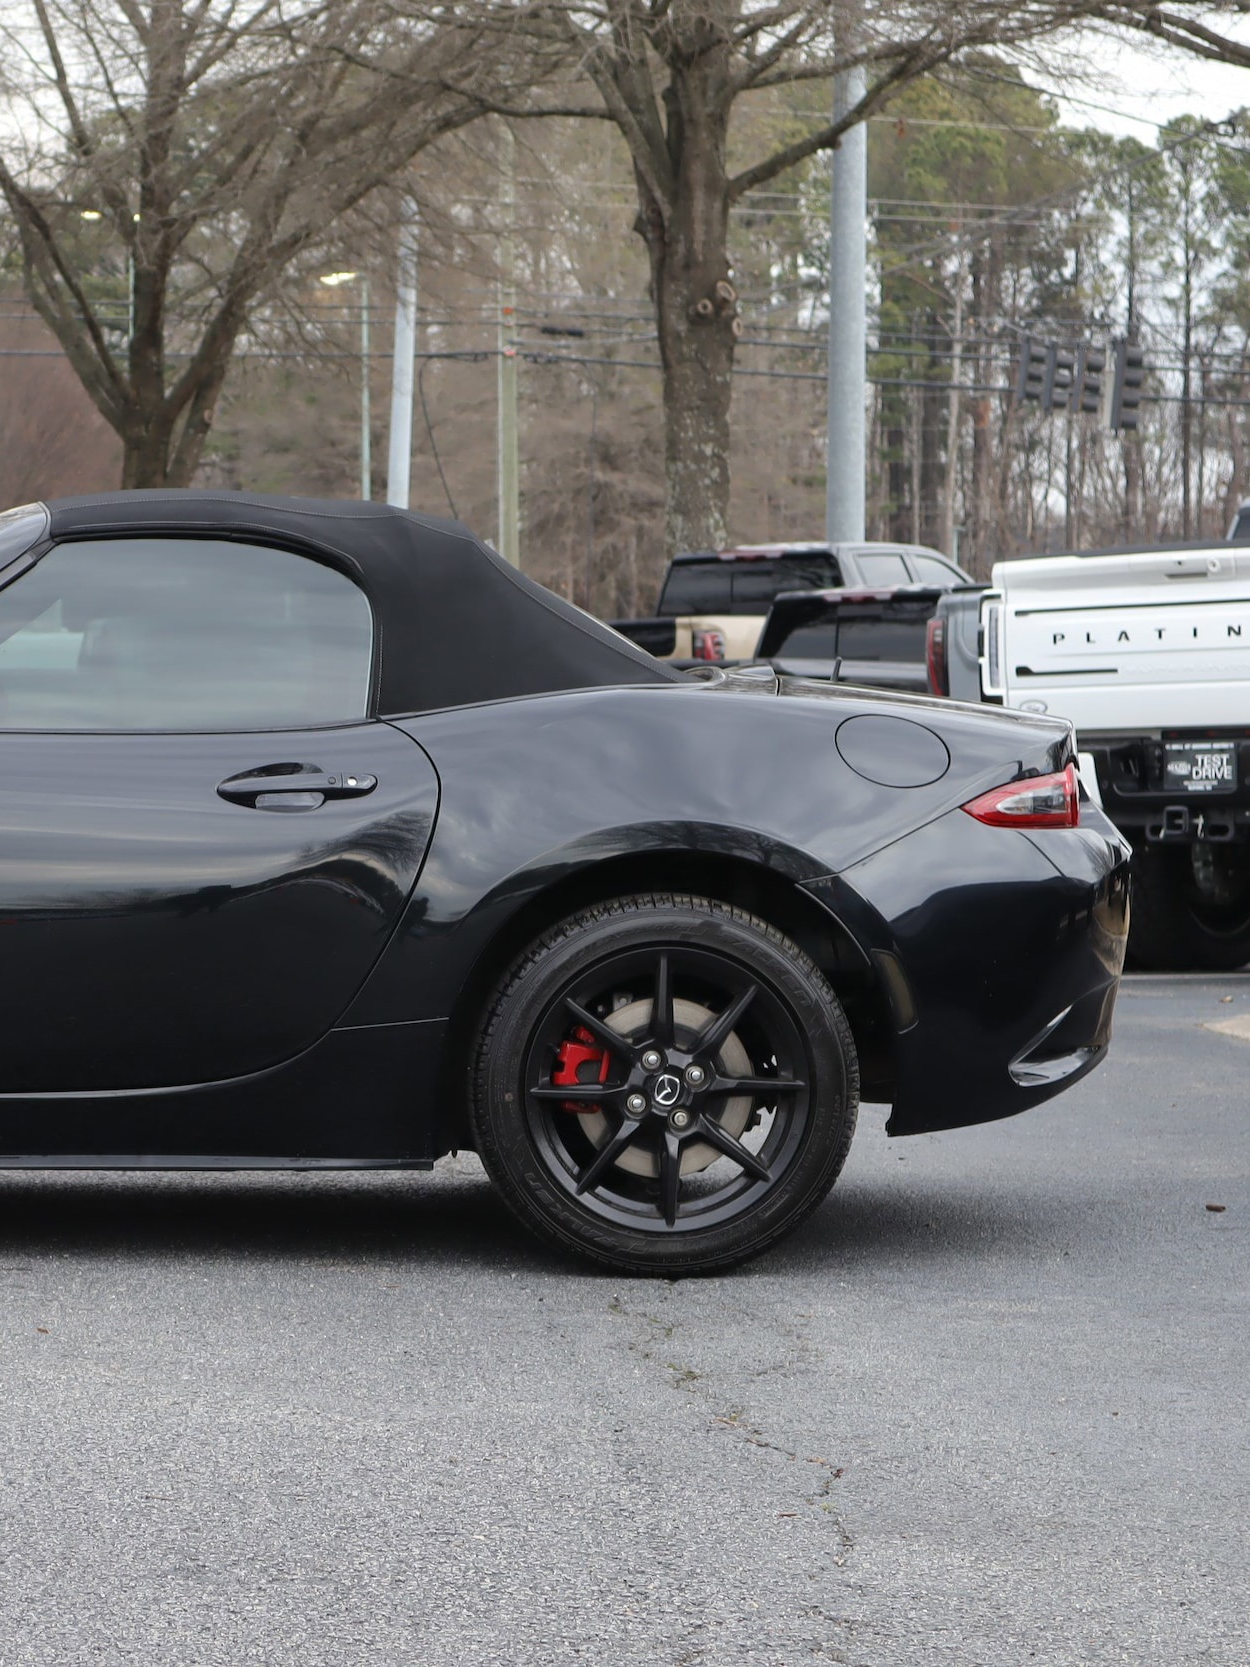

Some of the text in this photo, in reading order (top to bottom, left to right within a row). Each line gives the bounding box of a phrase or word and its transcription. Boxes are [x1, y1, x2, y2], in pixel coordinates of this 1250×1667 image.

[1053, 625, 1242, 645] PLATIN
[1195, 753, 1230, 768] TEST
[1192, 766, 1233, 780] DRIVE
